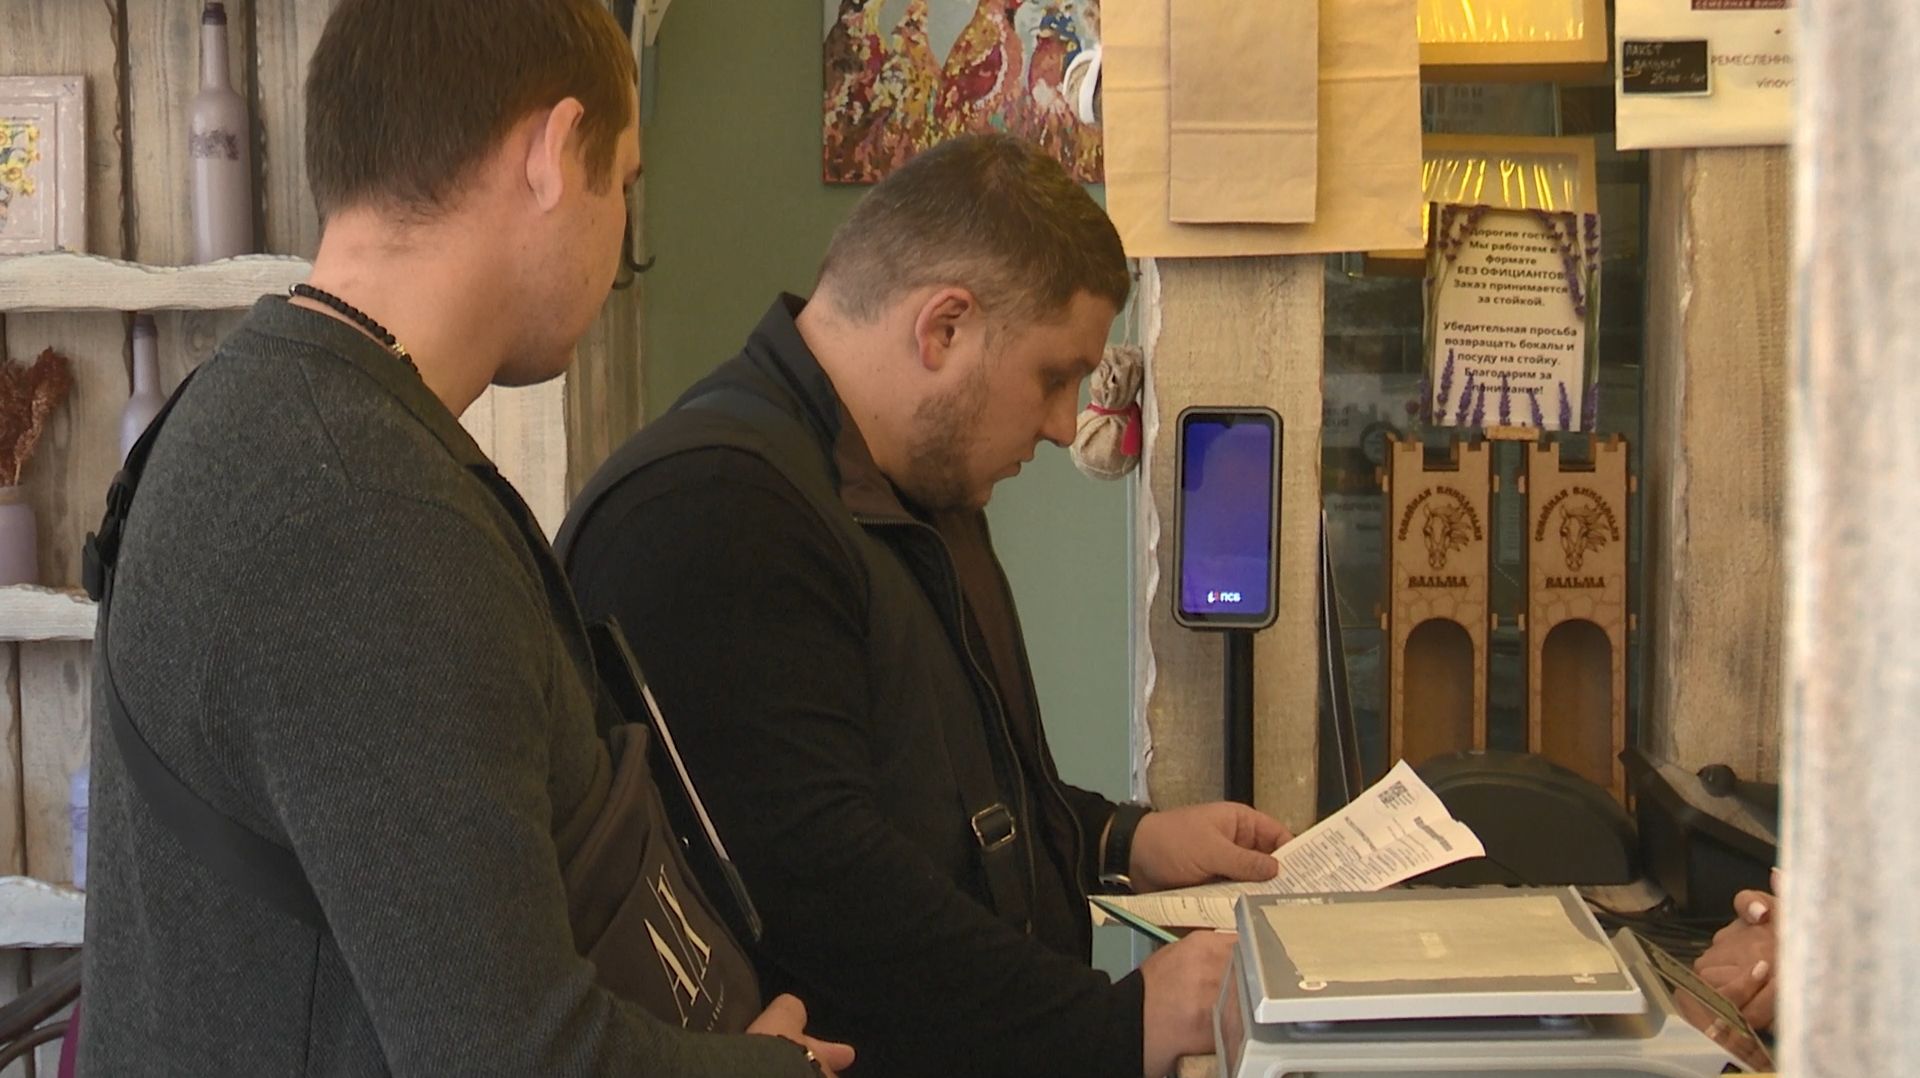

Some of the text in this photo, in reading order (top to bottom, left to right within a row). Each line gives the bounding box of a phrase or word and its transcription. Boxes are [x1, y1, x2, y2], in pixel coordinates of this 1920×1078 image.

[1469, 240, 1488, 250] Мы
[1491, 241, 1547, 254] работаем
[1485, 255, 1537, 266] формате
[1457, 266, 1564, 281] БЕЗ ОФИЦИАНТОВ
[1453, 279, 1569, 295] Заказ принимается
[1477, 294, 1546, 307] за стойкой.
[1443, 321, 1577, 338] Убедительная просьба
[1444, 337, 1575, 351] возвращать бокалы и
[1457, 353, 1561, 367] посуду на стойку.
[1539, 372, 1552, 380] за
[1408, 576, 1469, 588] ВАЛЬМА
[1545, 577, 1606, 588] ВАЛЬМА
